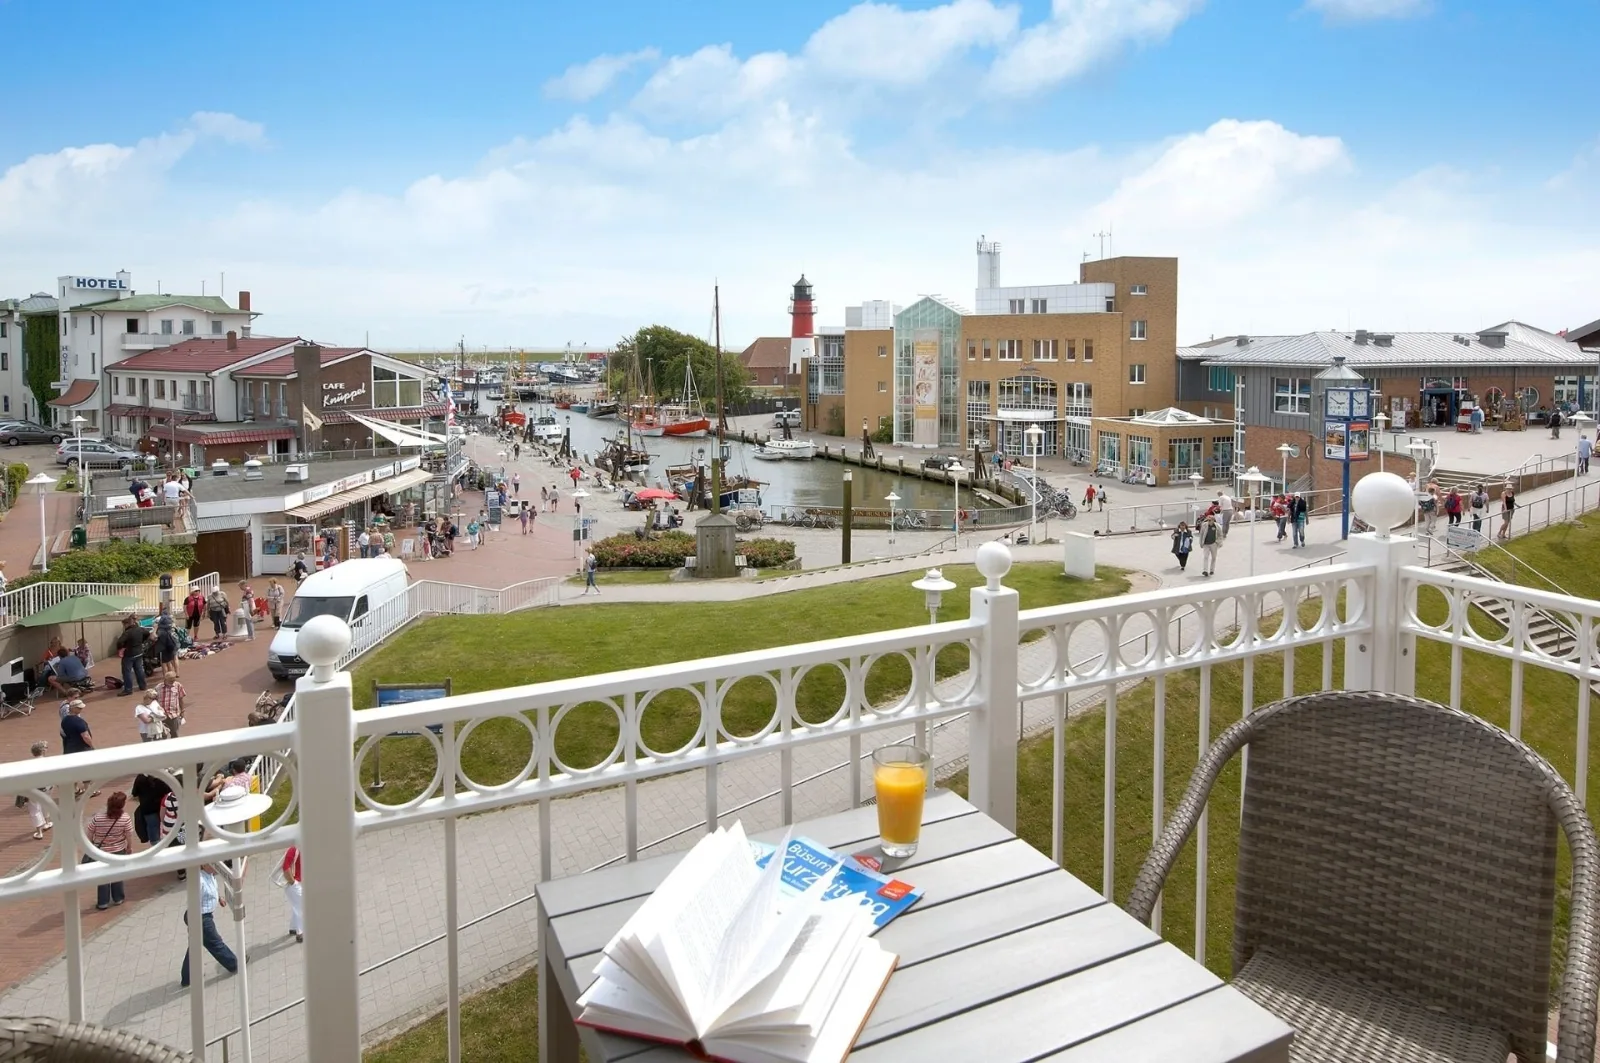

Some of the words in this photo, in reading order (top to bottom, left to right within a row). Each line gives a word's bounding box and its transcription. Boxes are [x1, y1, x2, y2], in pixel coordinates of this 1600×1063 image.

[76, 278, 127, 289] HOTEL
[322, 382, 346, 390] CAFE
[323, 382, 366, 408] Knüppel
[787, 843, 846, 877] Büsumr
